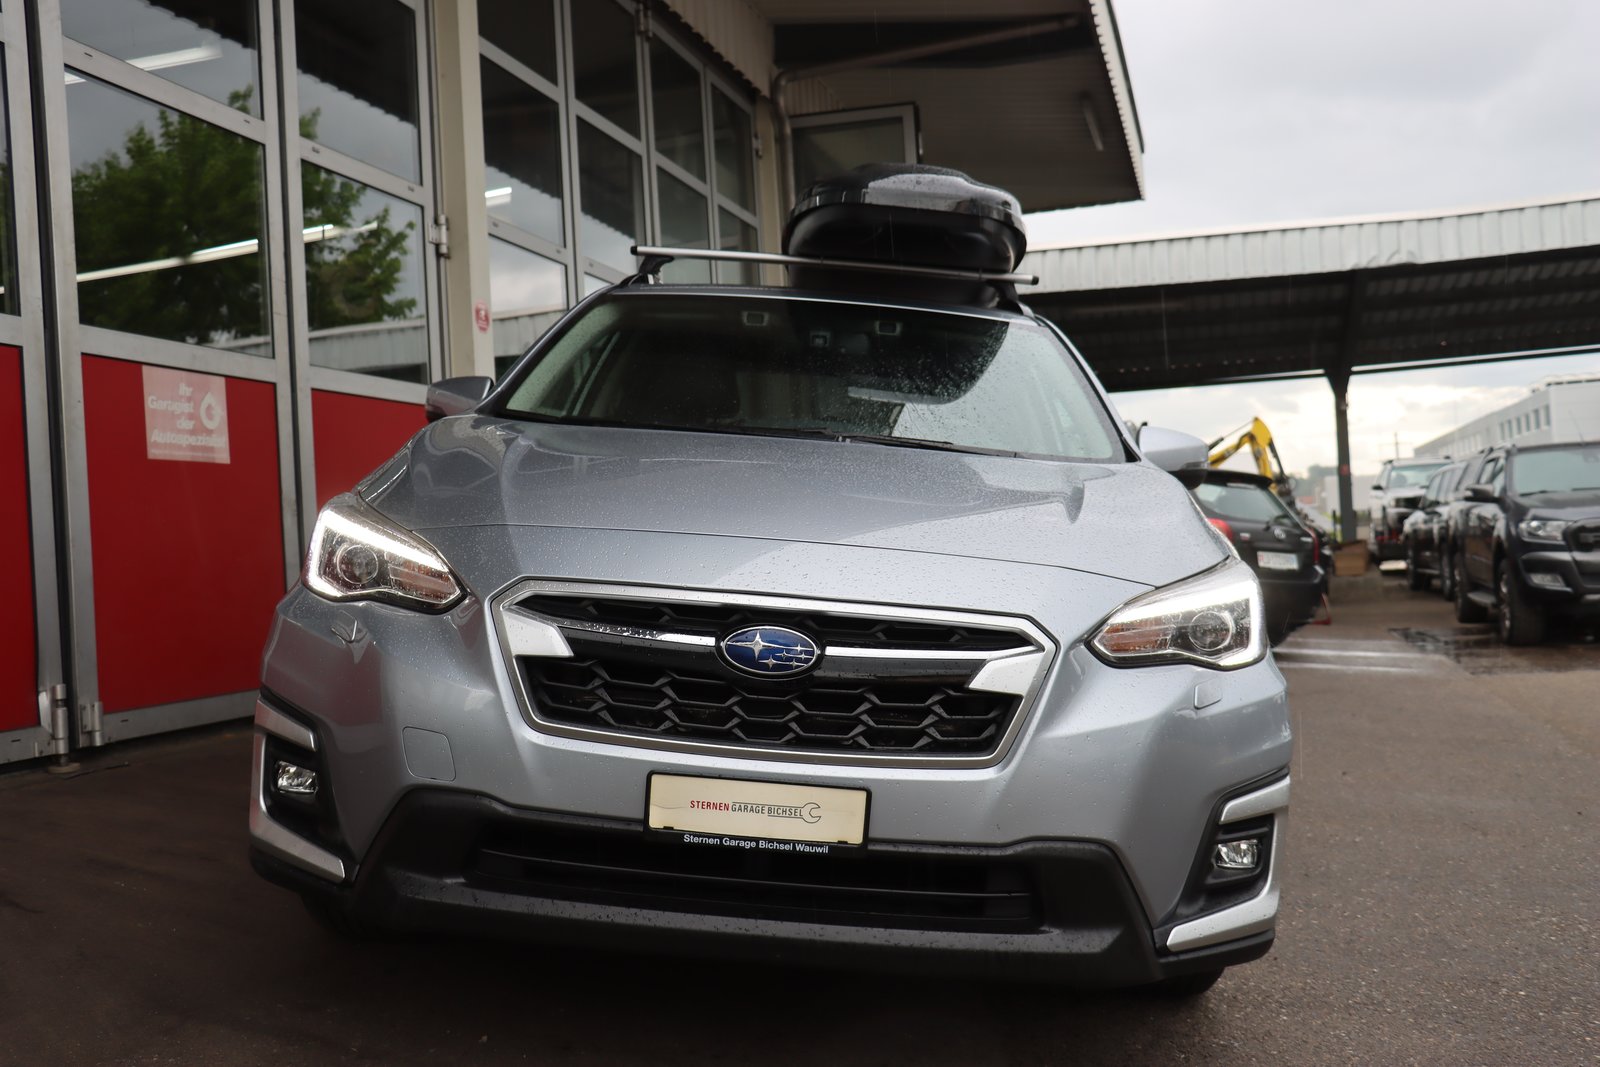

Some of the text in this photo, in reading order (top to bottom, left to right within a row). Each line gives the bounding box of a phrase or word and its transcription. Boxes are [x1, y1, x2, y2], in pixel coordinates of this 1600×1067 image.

[176, 417, 195, 430] der
[683, 834, 829, 854] Sternen Garage Bichsel Wauwil
